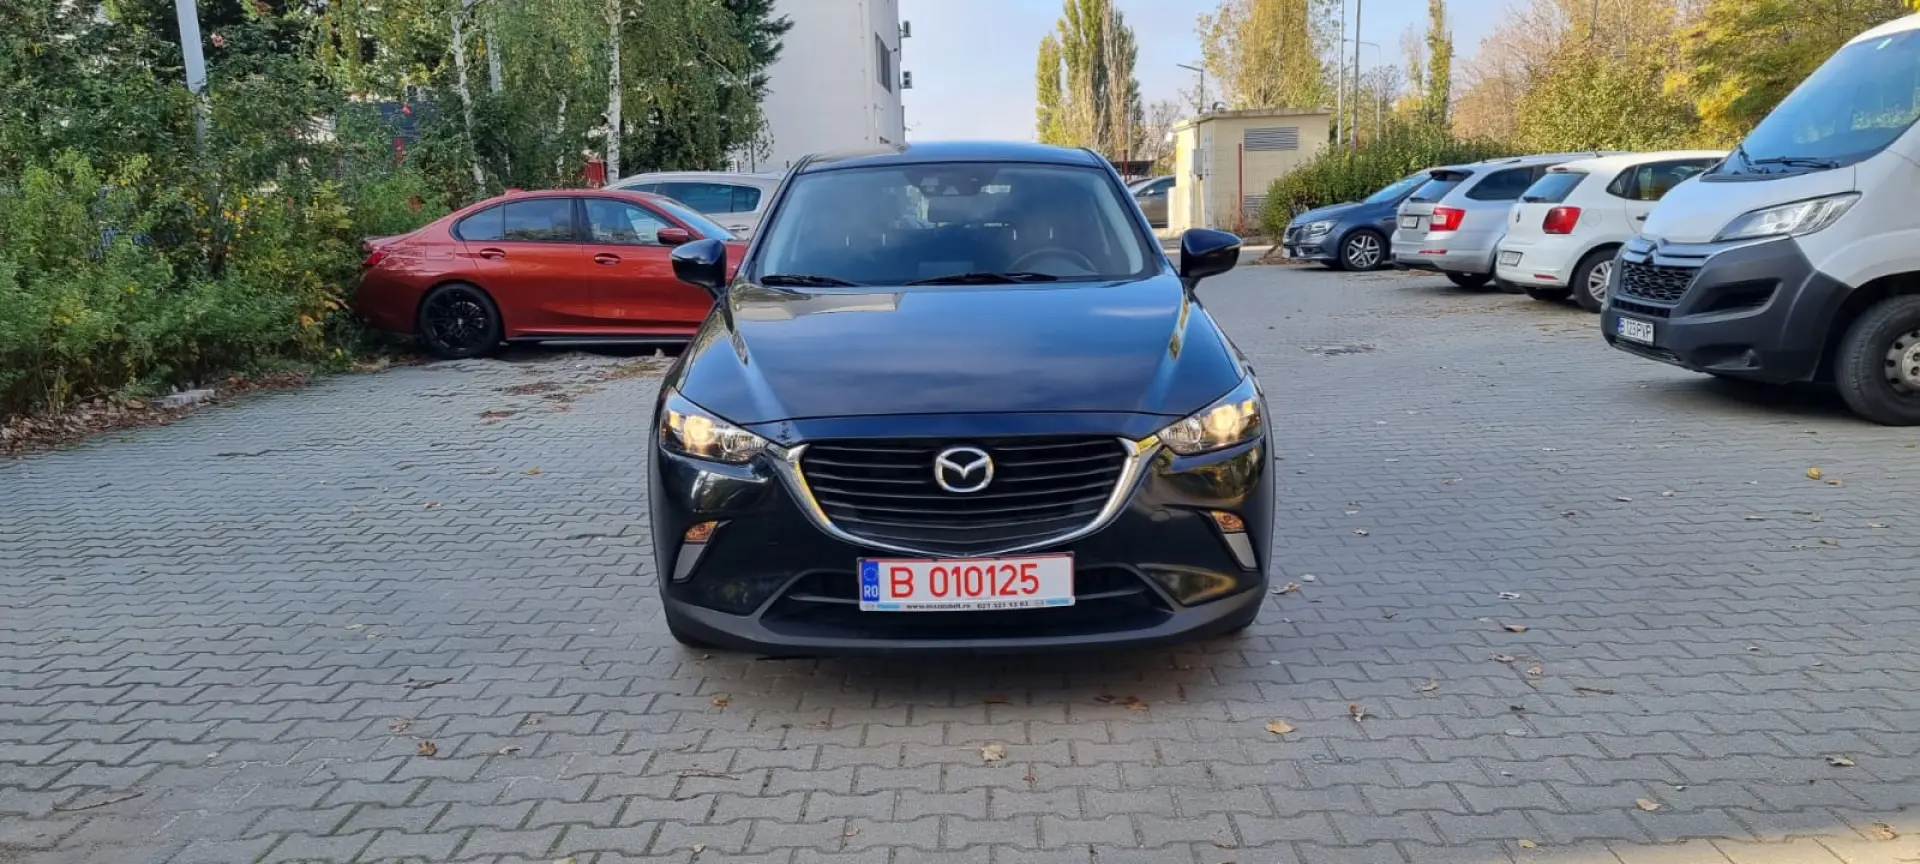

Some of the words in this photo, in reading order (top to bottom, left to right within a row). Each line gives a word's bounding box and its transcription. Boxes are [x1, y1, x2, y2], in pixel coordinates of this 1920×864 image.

[864, 585, 878, 598] RO
[889, 566, 914, 598] B
[929, 563, 1039, 598] 010125
